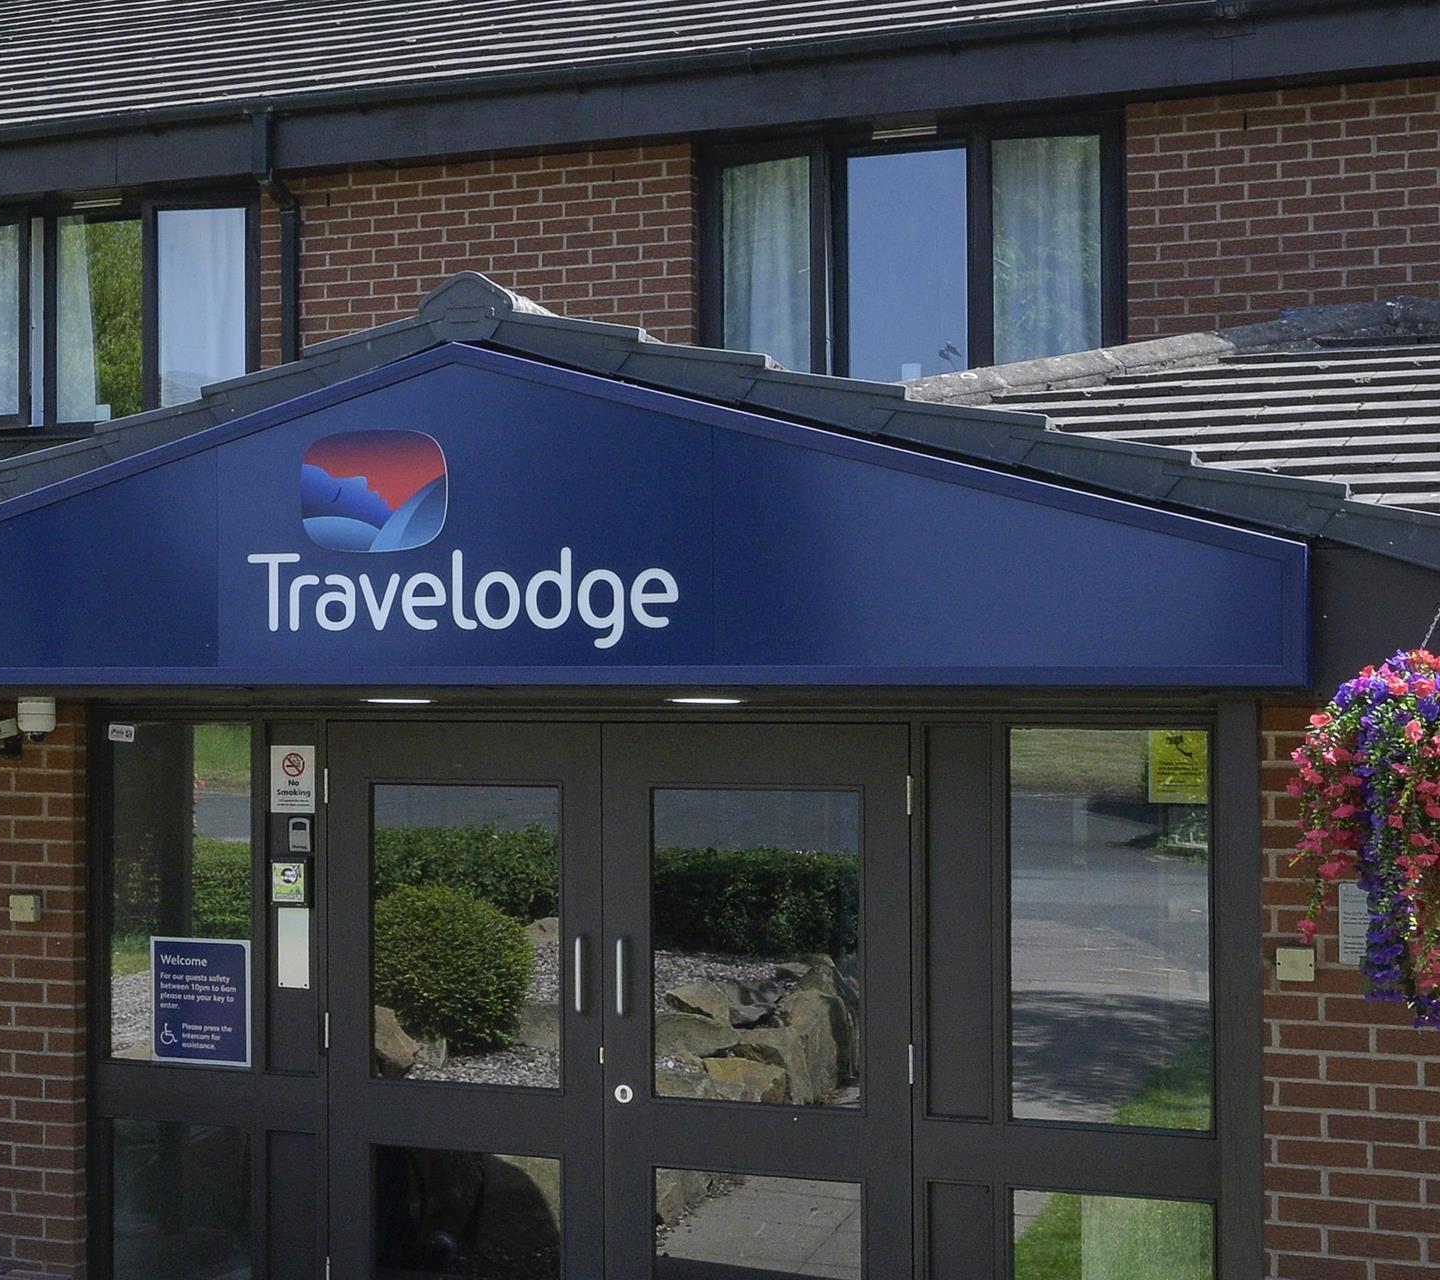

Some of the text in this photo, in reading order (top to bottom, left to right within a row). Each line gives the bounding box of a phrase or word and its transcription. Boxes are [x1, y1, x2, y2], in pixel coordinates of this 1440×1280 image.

[247, 546, 679, 649] Travelodge
[276, 789, 311, 797] Smoking
[160, 954, 208, 967] Welcome
[185, 974, 207, 982] guests
[209, 975, 231, 984] safety
[160, 982, 189, 991] between
[191, 984, 210, 993] 10pm
[220, 985, 237, 993] 6am
[160, 991, 182, 1000] please
[196, 994, 212, 1003] your
[213, 994, 225, 1004] key
[181, 1023, 202, 1031] Please
[221, 1025, 232, 1033] the
[182, 1032, 221, 1041] intercom for
